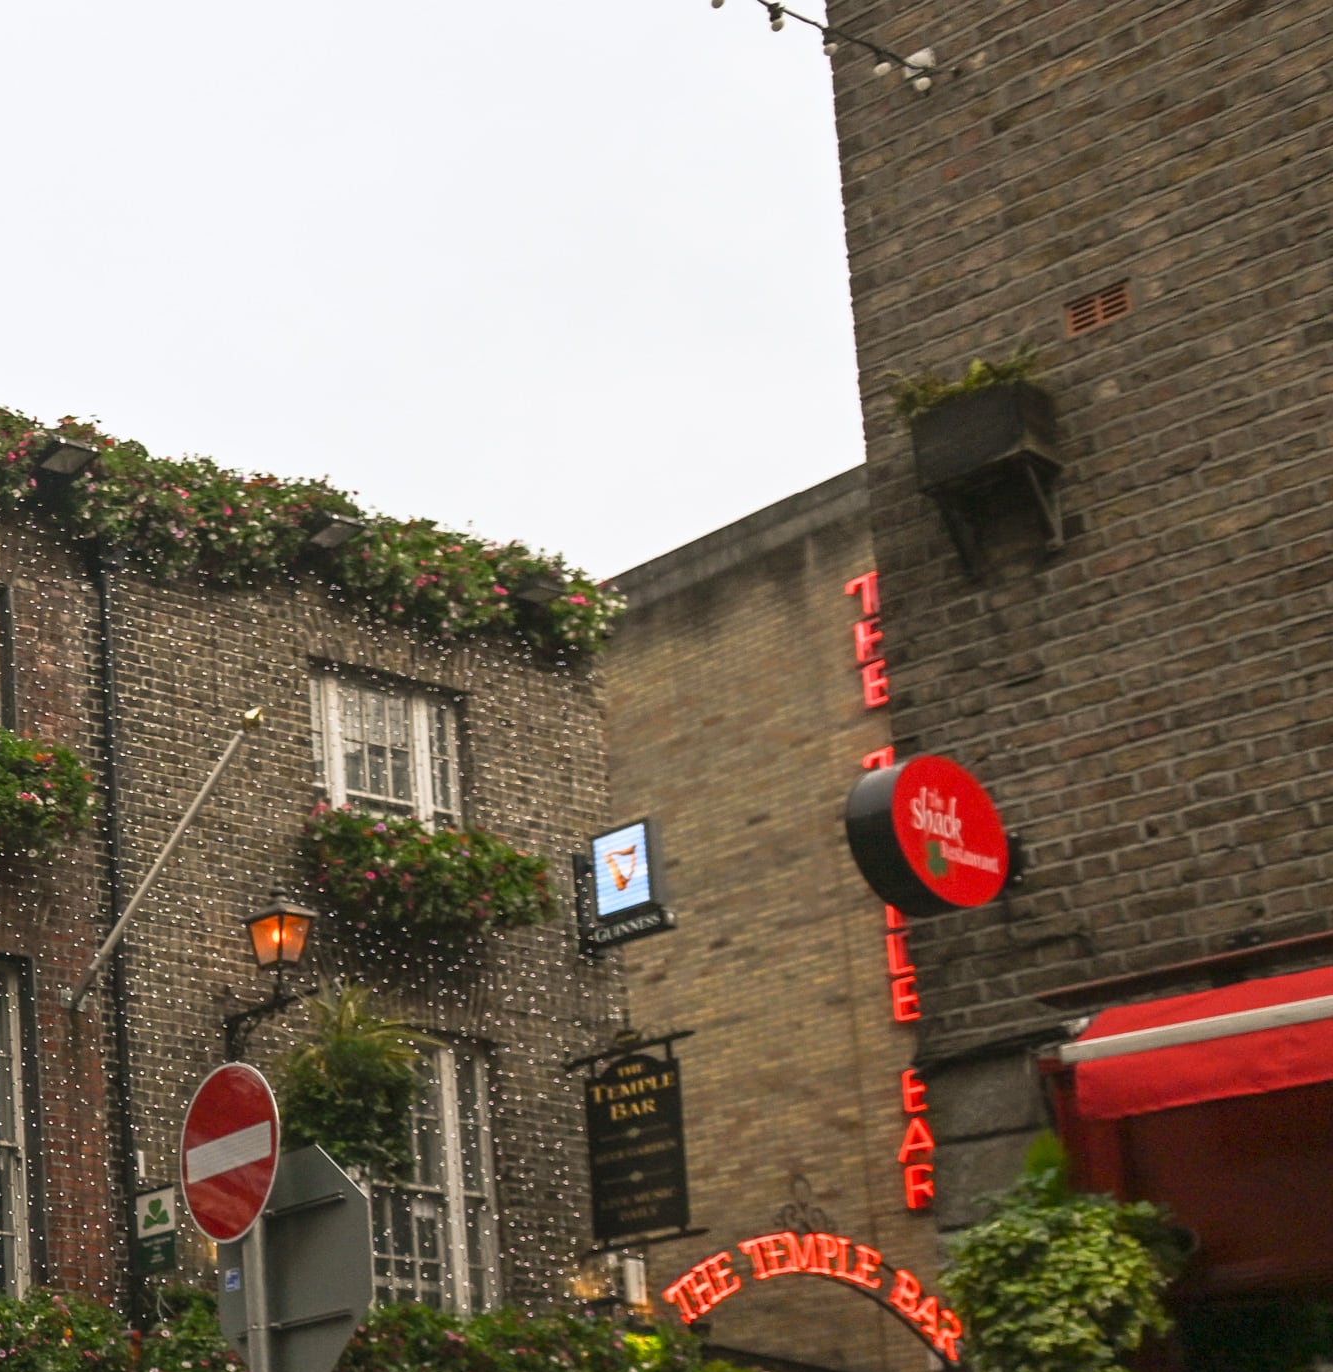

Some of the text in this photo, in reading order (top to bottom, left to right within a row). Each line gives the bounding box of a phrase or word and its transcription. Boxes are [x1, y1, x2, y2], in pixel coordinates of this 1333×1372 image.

[616, 1063, 643, 1077] THE
[590, 1072, 675, 1104] TEMPLE
[610, 1098, 657, 1121] BAR
[662, 1231, 963, 1361] THE TEMPLE BAR
